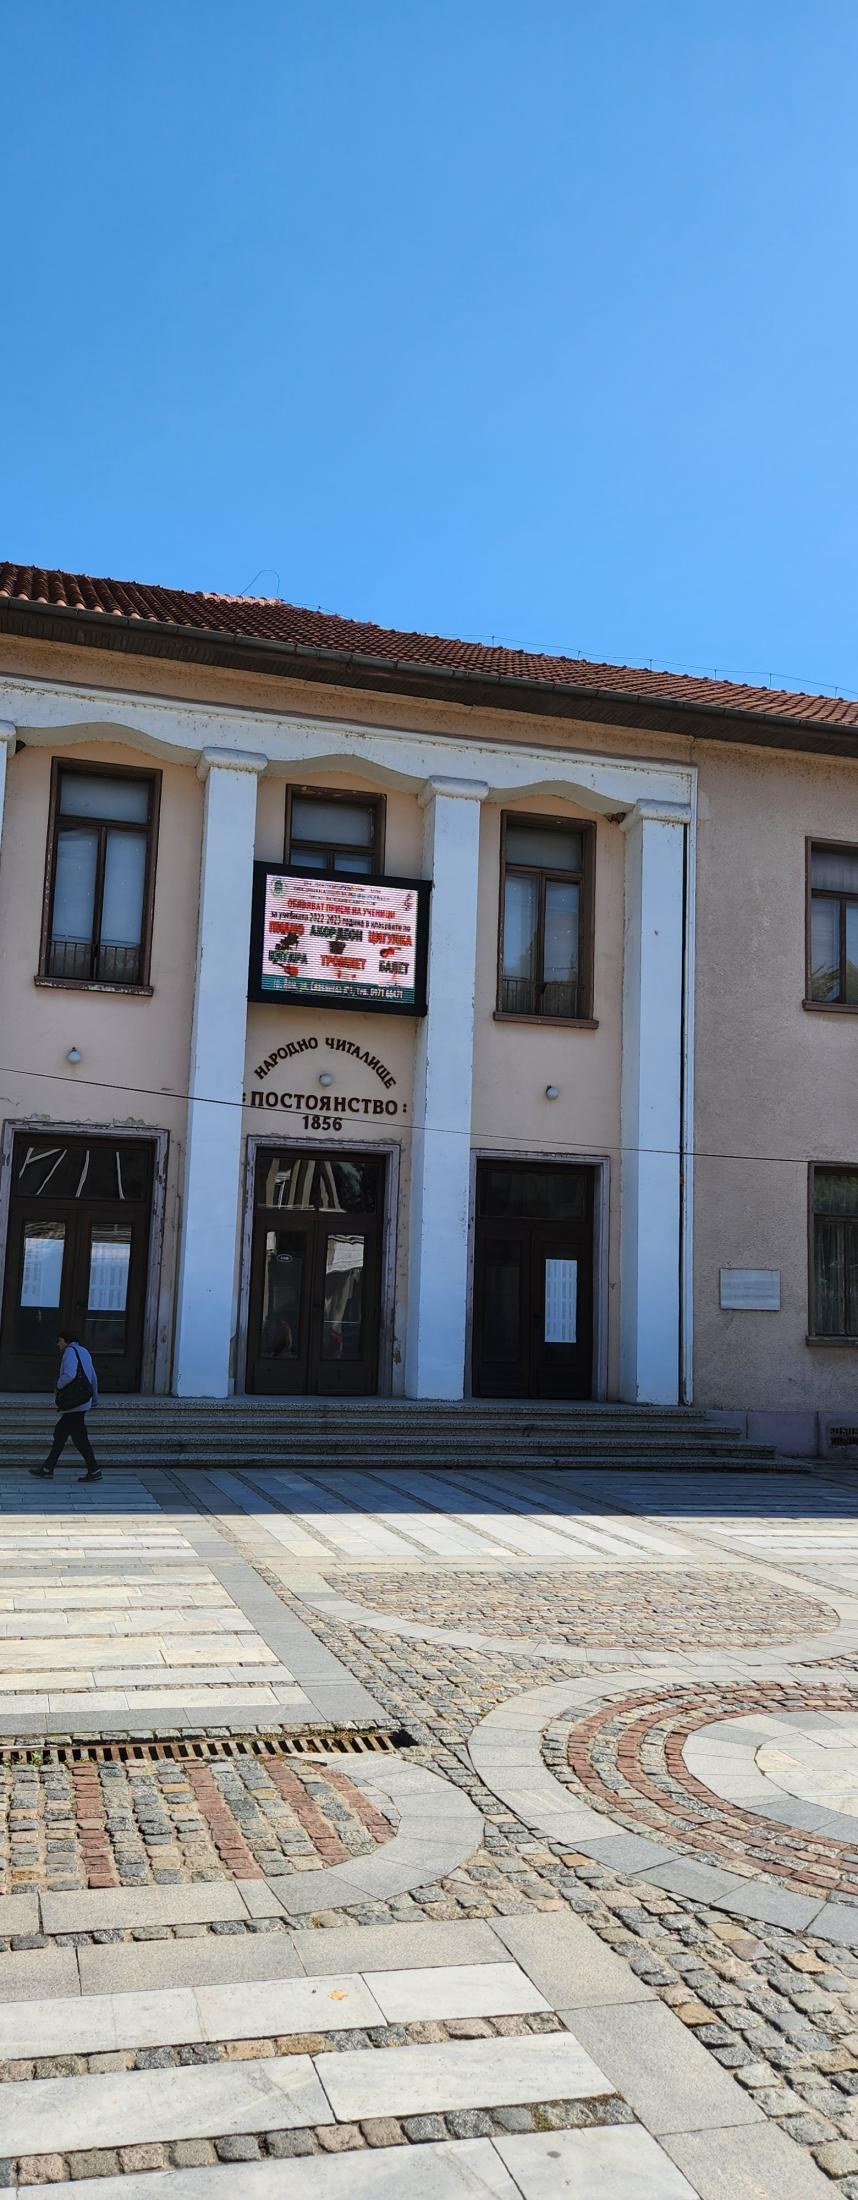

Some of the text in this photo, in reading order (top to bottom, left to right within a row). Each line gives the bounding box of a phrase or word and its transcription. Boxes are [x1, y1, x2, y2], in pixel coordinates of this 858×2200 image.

[350, 907, 362, 916] НА
[311, 926, 363, 942] АКОРДЕОН
[379, 961, 410, 974] БАЛЕТ
[253, 1037, 397, 1089] НАРОДНО ЧИТАЛИЩЕ
[250, 1090, 398, 1116] ПОСТОЯНСТВО
[302, 1115, 343, 1131] 1856
